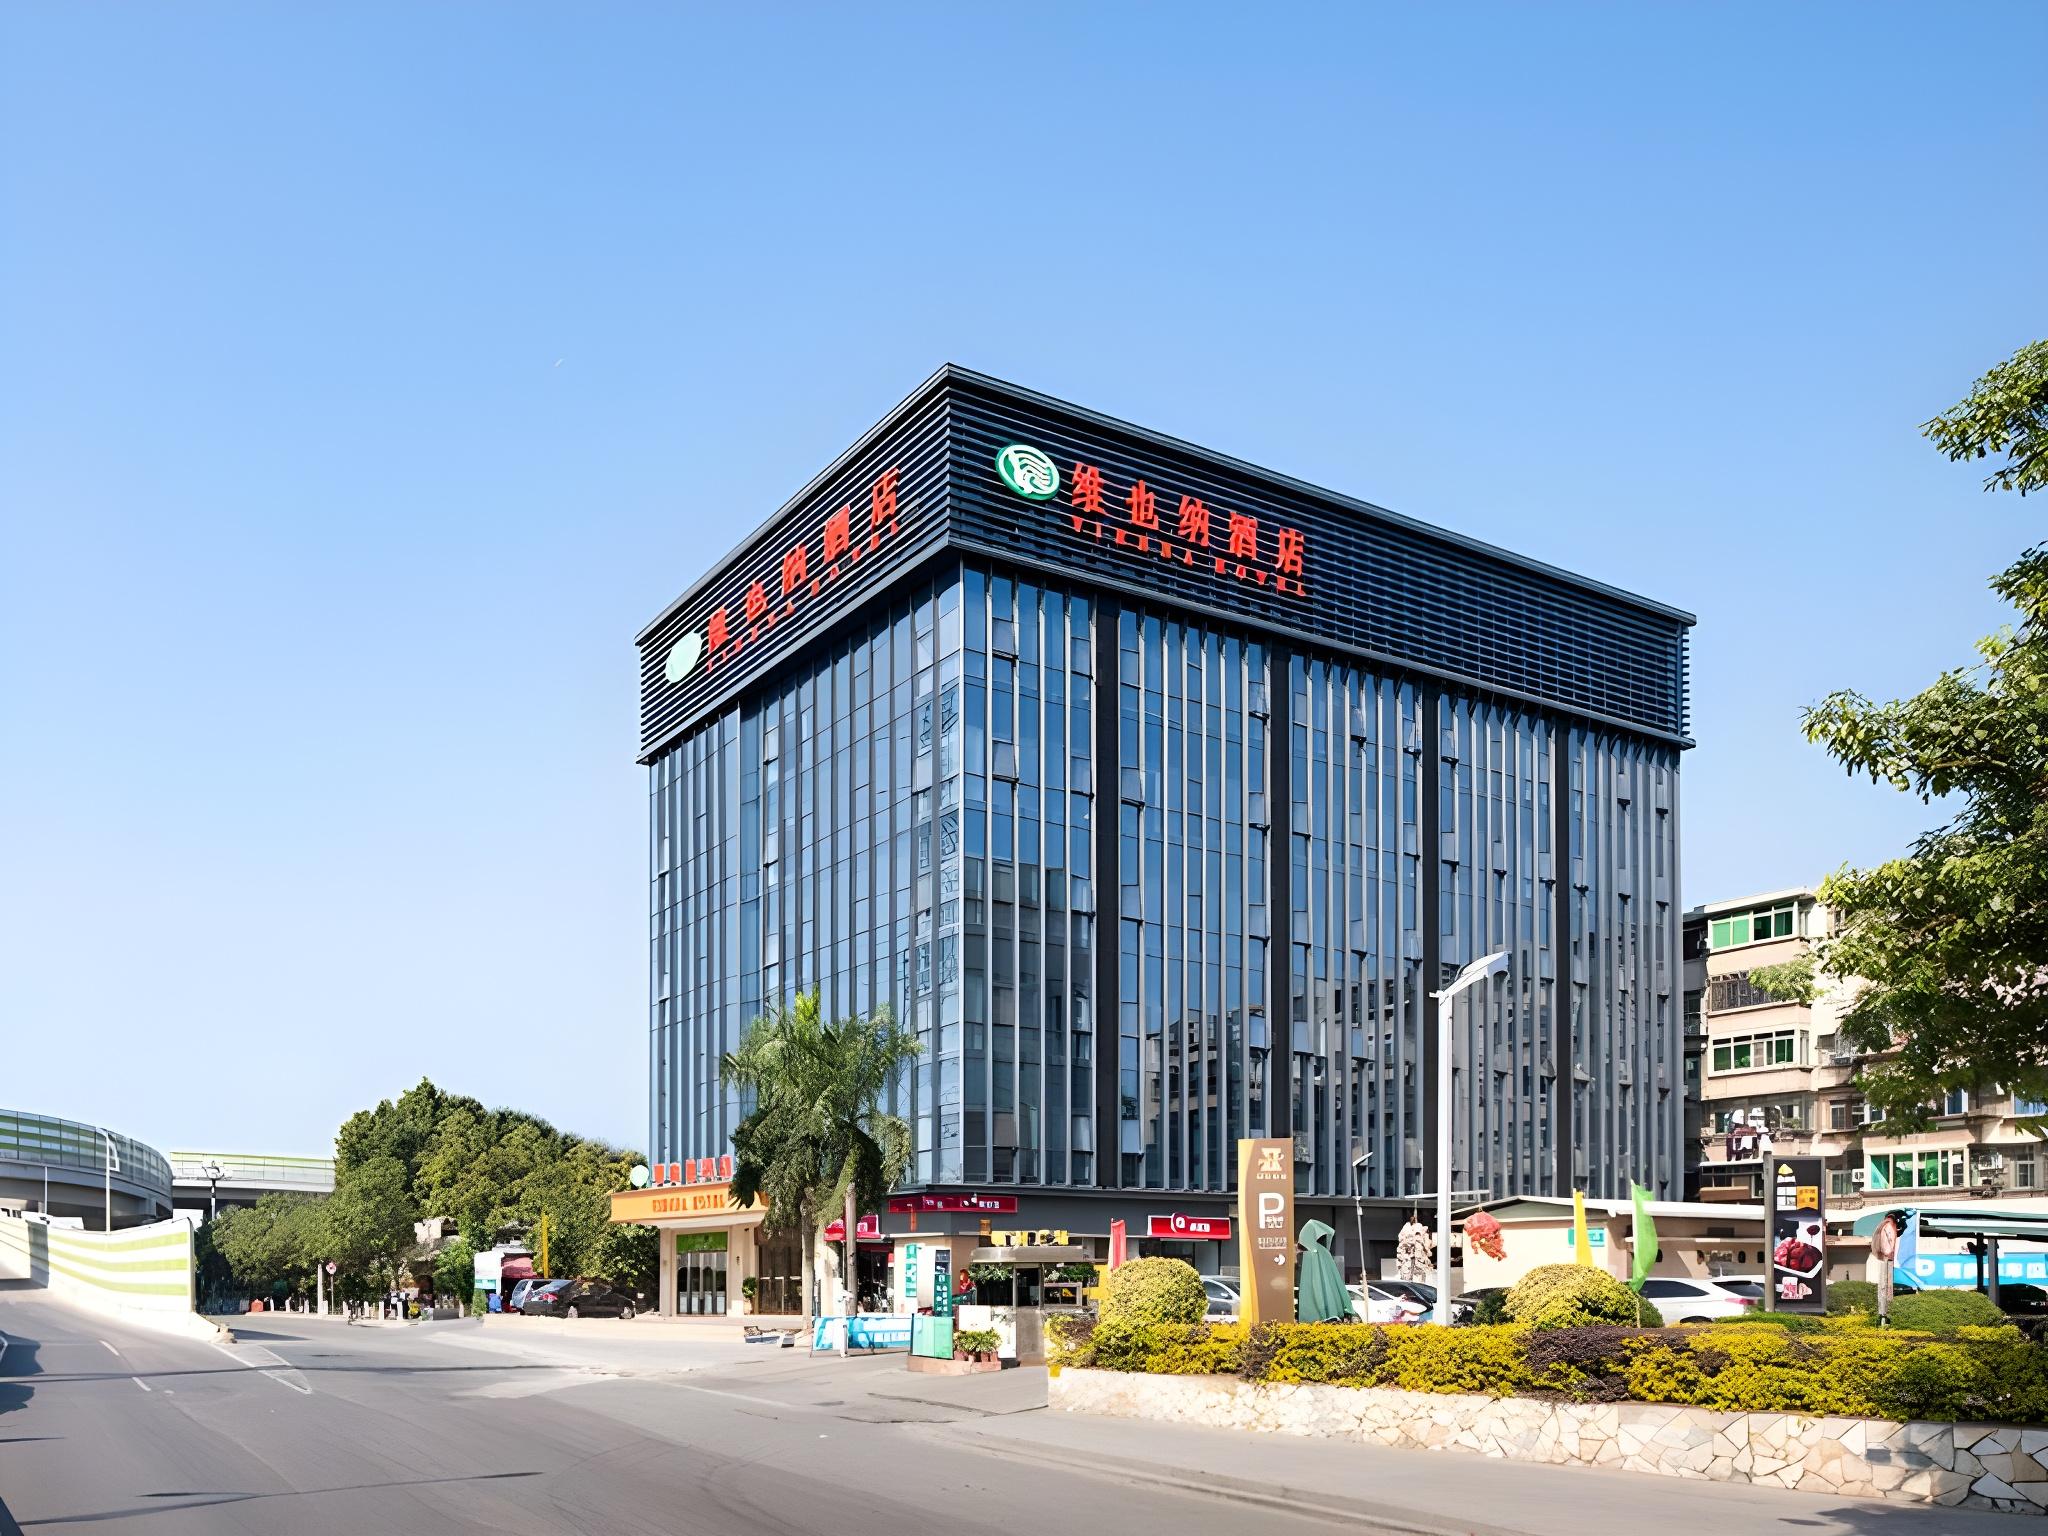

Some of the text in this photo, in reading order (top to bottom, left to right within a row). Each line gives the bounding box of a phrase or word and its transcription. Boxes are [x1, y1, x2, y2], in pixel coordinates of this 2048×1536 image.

[1072, 462, 1304, 577] 维也纳酒店
[1258, 1192, 1285, 1229] P
